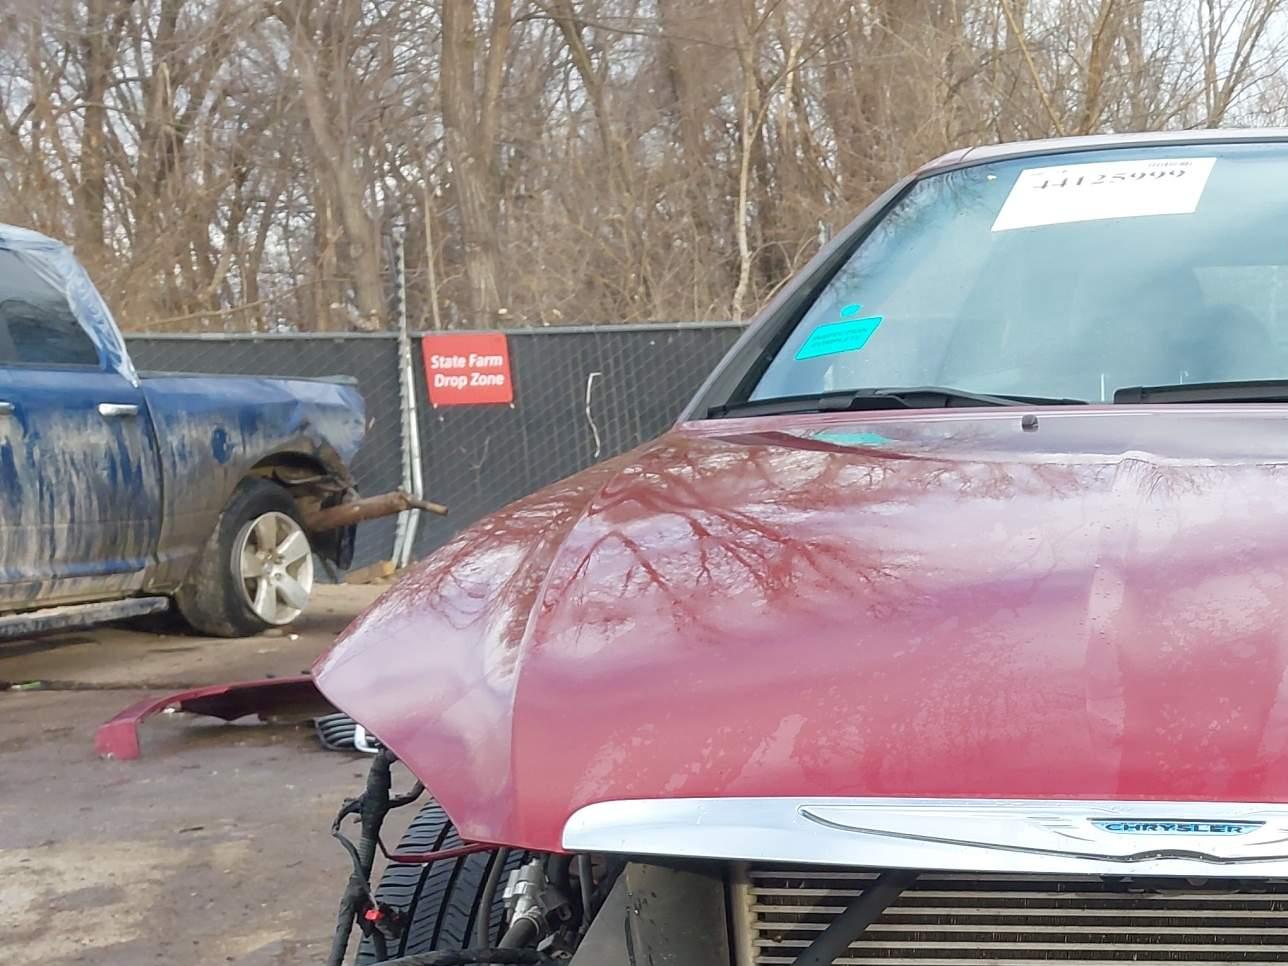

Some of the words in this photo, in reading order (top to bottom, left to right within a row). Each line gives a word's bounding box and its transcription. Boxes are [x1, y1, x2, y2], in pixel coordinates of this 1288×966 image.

[431, 354, 467, 369] State
[469, 353, 503, 367] Farm
[434, 373, 468, 390] Drop
[470, 372, 504, 386] Zone
[1105, 822, 1244, 834] CHRYSLER
